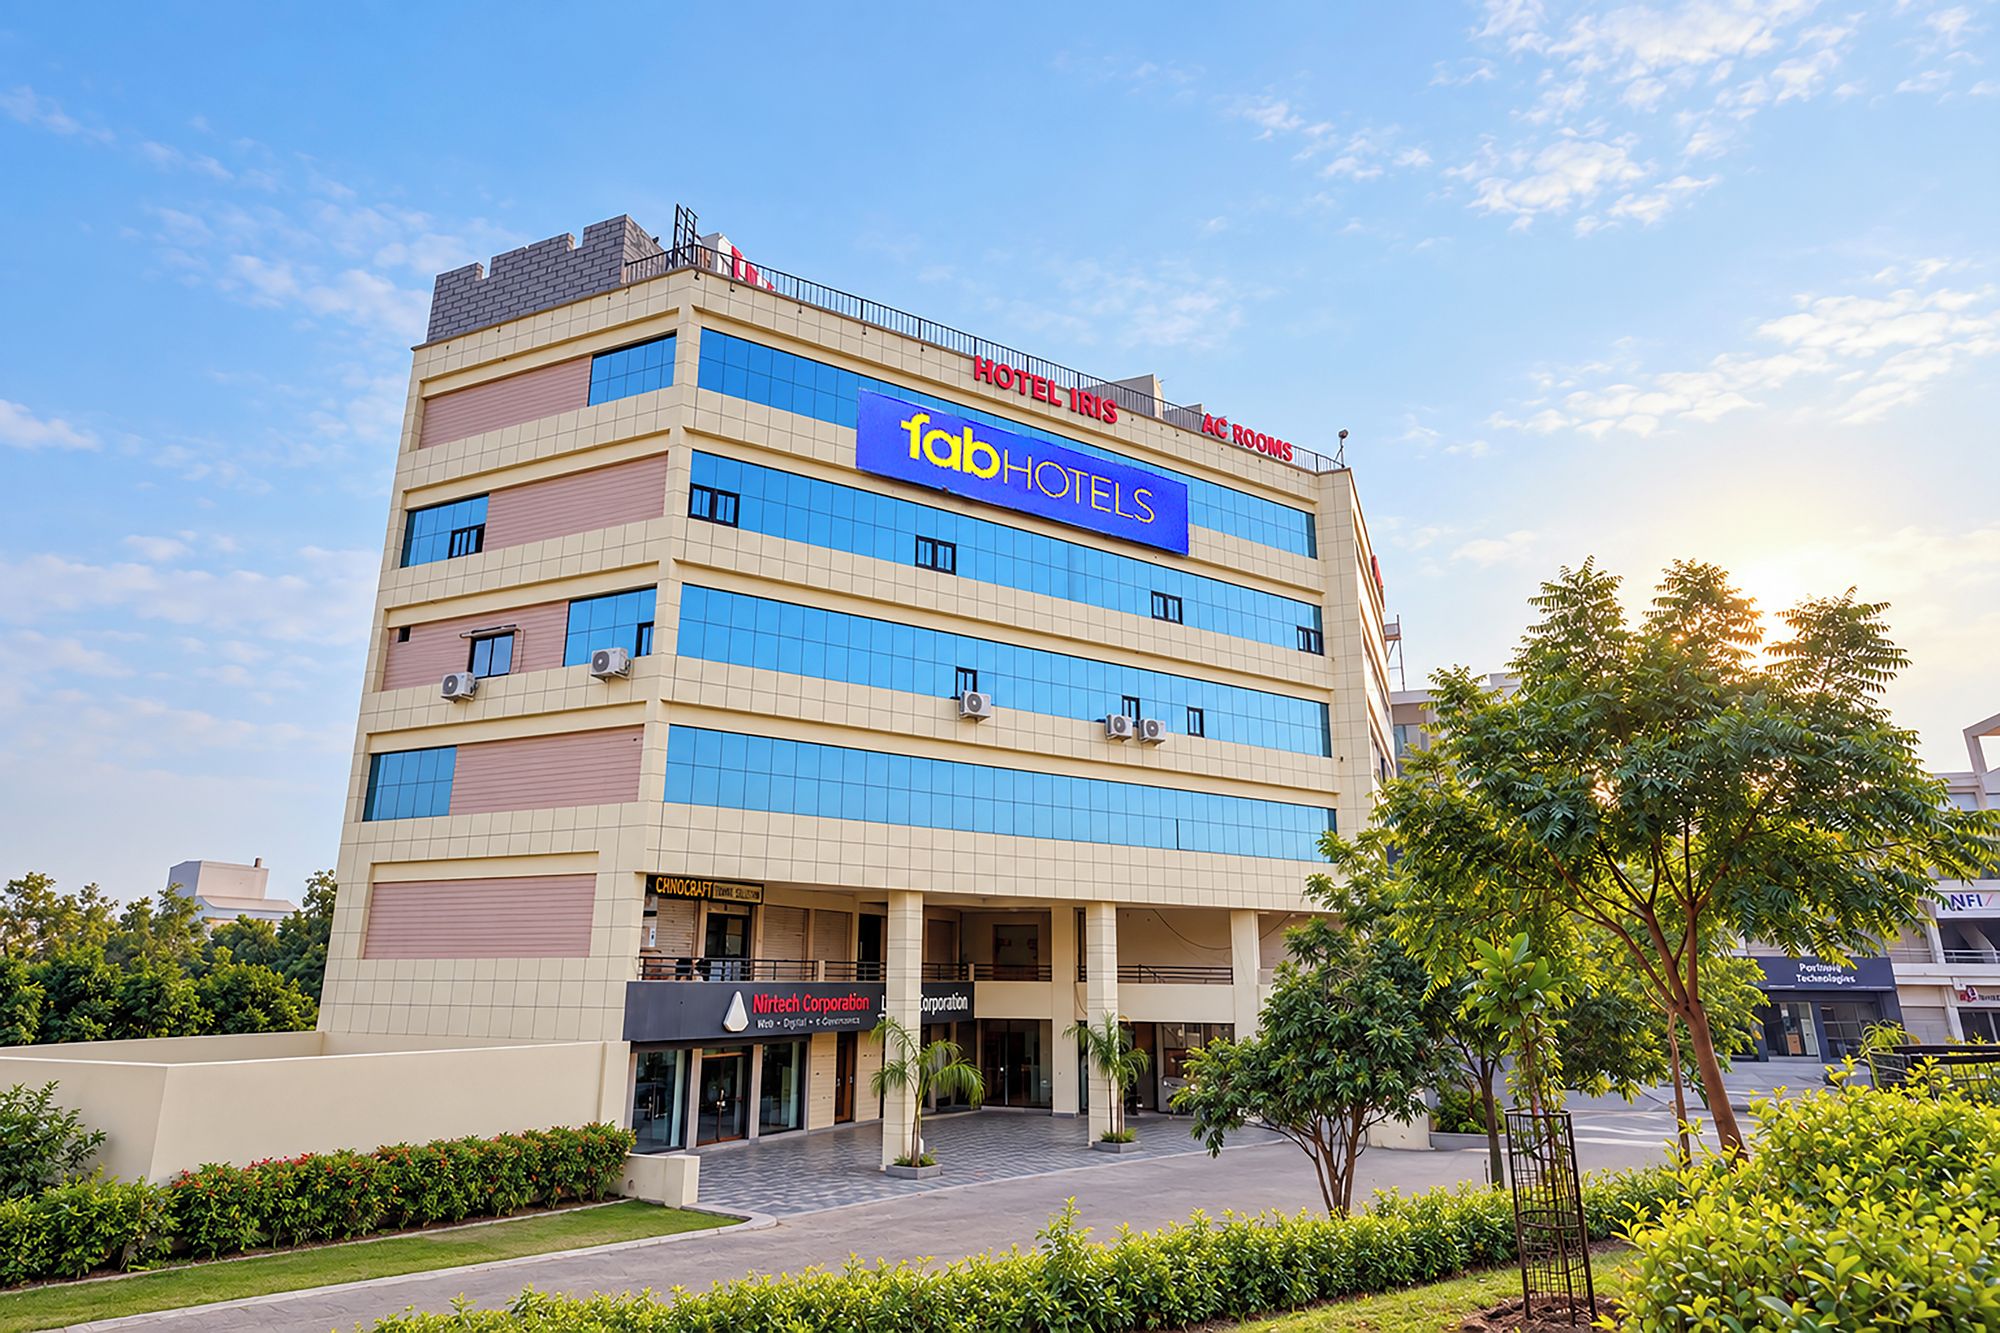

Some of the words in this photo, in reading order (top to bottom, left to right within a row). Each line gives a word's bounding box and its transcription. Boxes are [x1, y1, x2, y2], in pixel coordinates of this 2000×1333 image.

[974, 355, 1062, 407] HOTEL
[1070, 387, 1119, 424] IRIS
[1202, 412, 1228, 439] AC
[1232, 423, 1294, 462] ROOMS
[752, 992, 800, 1014] Nirtech
[802, 992, 870, 1015] Corporation
